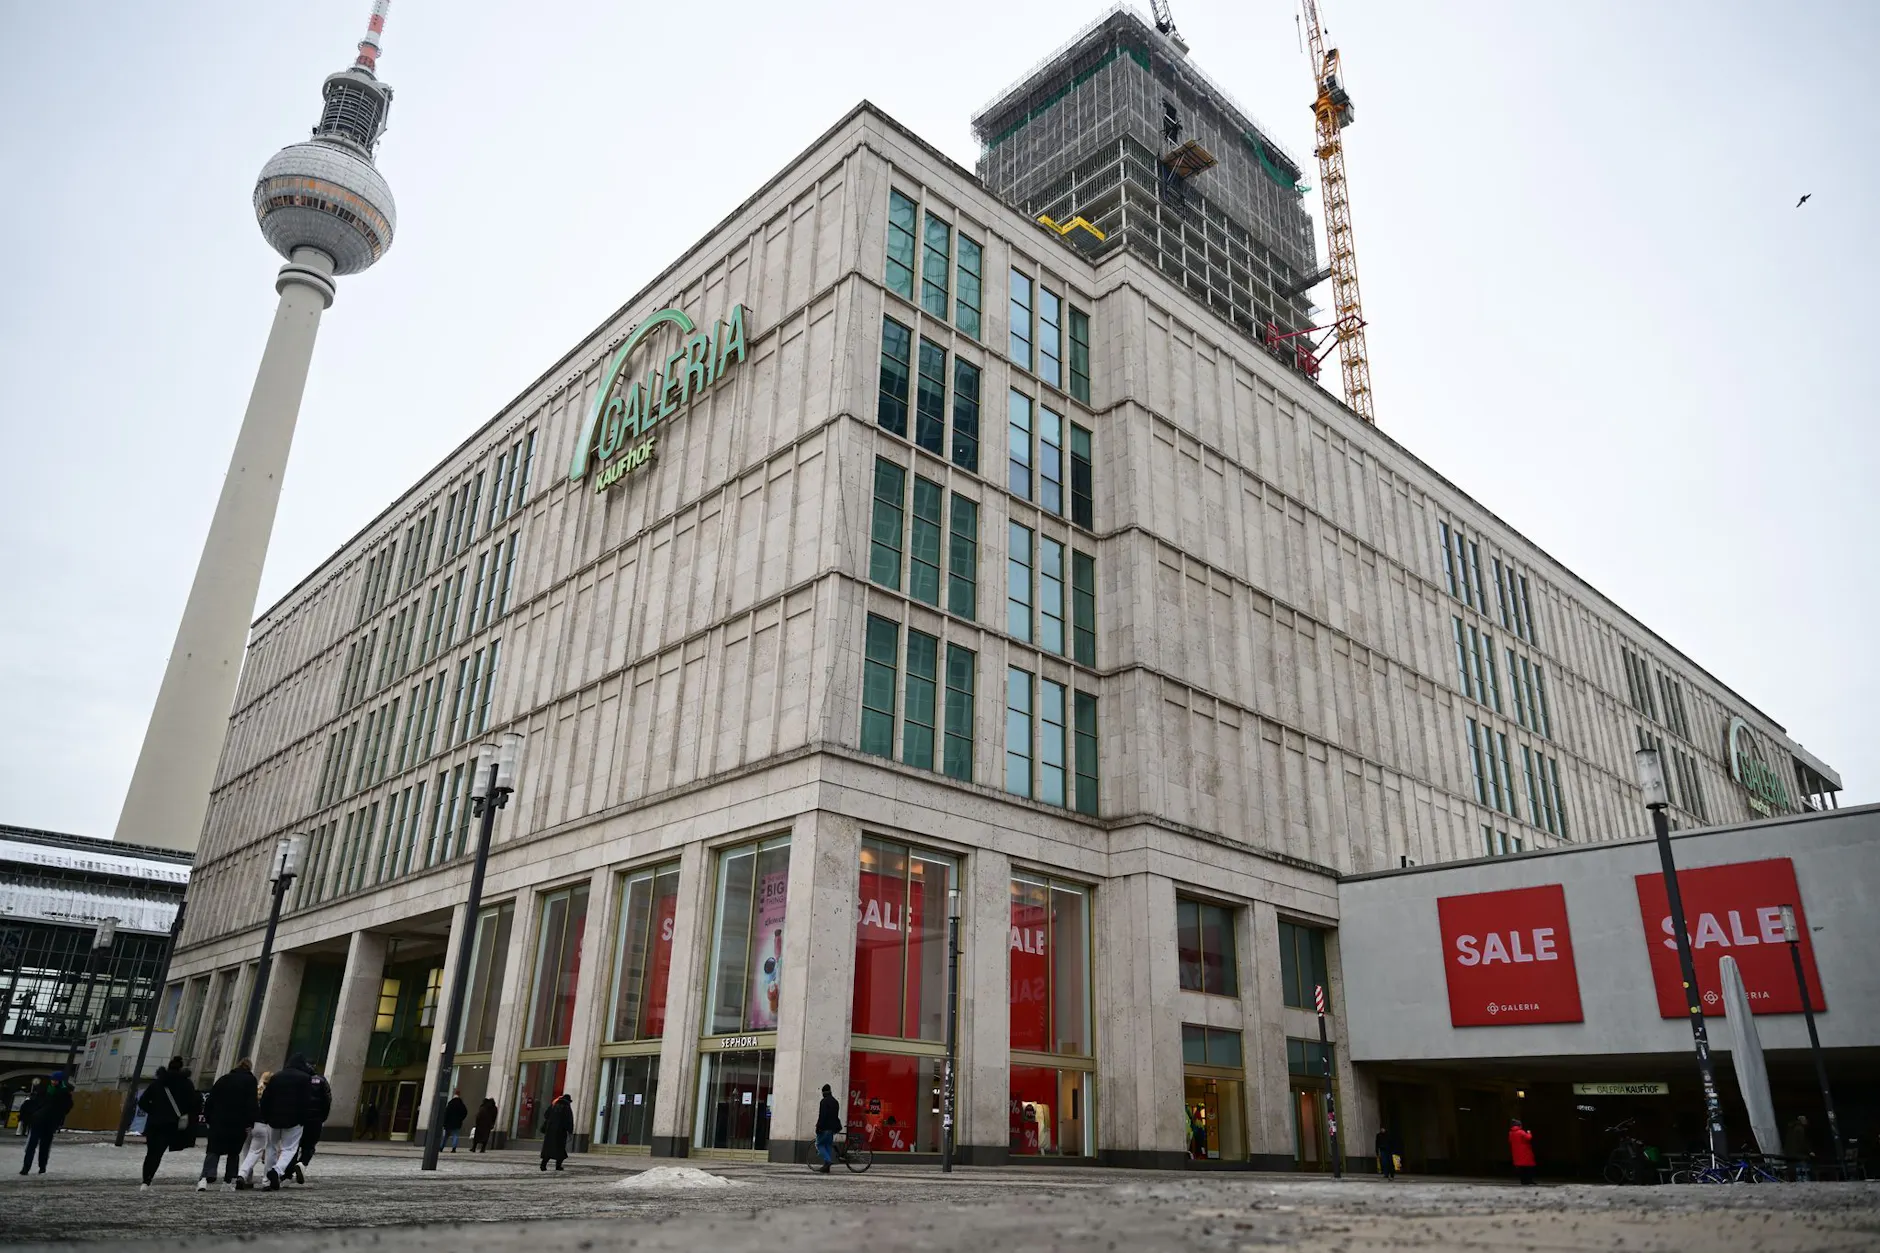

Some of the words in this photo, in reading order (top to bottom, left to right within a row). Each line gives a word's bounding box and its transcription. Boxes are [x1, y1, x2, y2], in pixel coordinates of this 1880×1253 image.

[599, 304, 747, 461] GALERIA
[767, 881, 785, 897] BIG
[857, 898, 912, 933] ALE
[1009, 925, 1044, 955] ALE
[1456, 927, 1558, 966] SALE
[1501, 1003, 1540, 1011] GALERIA
[721, 1036, 758, 1048] SEPHORA
[1597, 1085, 1625, 1093] GALERIA
